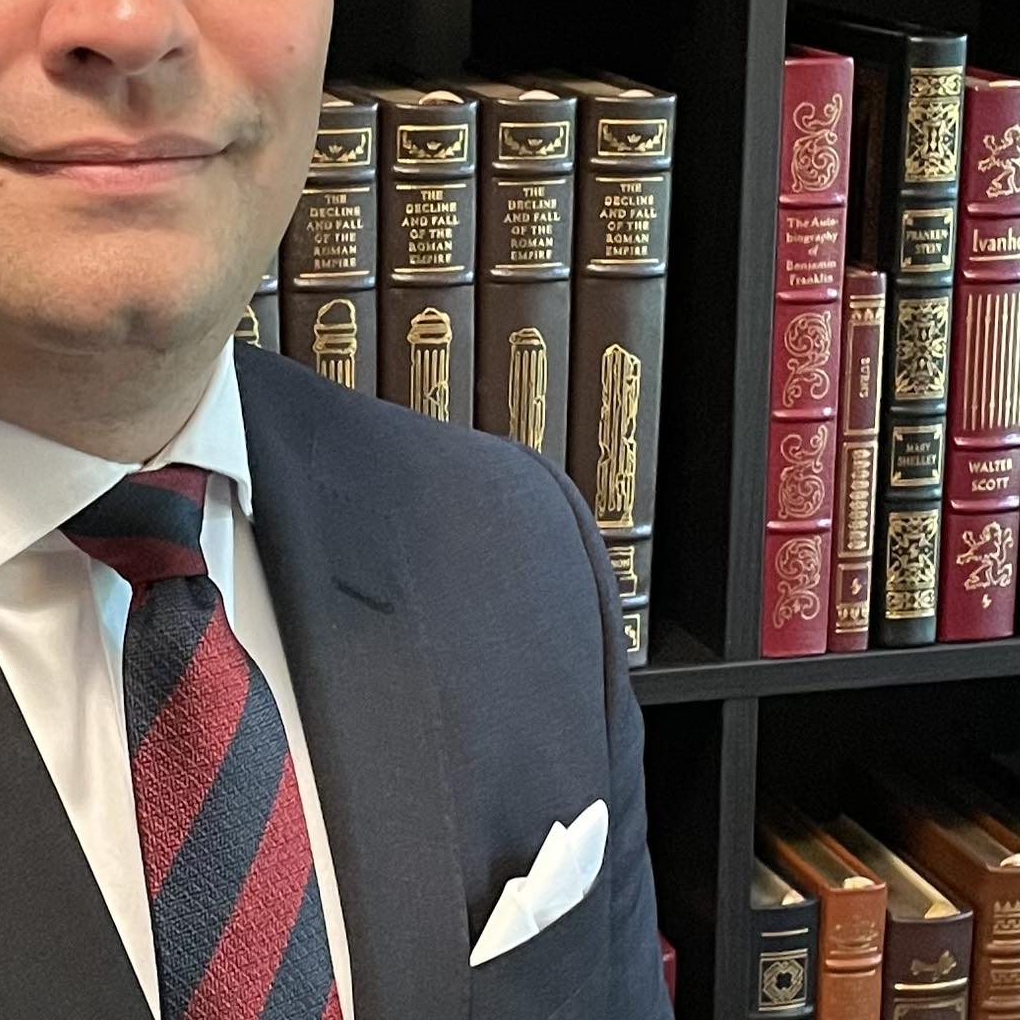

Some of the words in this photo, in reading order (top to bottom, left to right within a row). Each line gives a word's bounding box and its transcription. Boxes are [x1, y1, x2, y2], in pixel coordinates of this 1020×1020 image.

[522, 186, 545, 197] THE
[619, 183, 642, 193] THE
[325, 194, 347, 204] THE
[420, 190, 444, 201] THE
[604, 194, 654, 206] DECLINE
[405, 202, 457, 213] DECLINE
[508, 199, 557, 211] DECLINE
[309, 206, 361, 218] DECLINE
[503, 213, 530, 223] AND
[533, 211, 561, 222] FALL
[599, 209, 626, 219] AND
[629, 207, 658, 218] FALL
[306, 220, 333, 231] AND
[335, 217, 364, 229] FALL
[401, 216, 428, 227] AND
[431, 214, 460, 226] FALL
[607, 221, 622, 231] OF
[627, 220, 649, 230] THE
[786, 217, 809, 228] The
[410, 229, 424, 239] OF
[429, 228, 453, 239] THE
[511, 226, 527, 235] OF
[530, 224, 553, 234] THE
[314, 233, 329, 244] OF
[335, 232, 356, 242] THE
[510, 237, 554, 249] ROMAN
[605, 233, 649, 244] ROMAN
[786, 231, 838, 244] biography
[313, 245, 357, 256] ROMAN
[408, 240, 453, 252] ROMAN
[605, 245, 648, 257] EMPIRE
[808, 244, 819, 256] of
[915, 243, 942, 254] STEIN
[409, 253, 452, 265] EMPIRE
[510, 249, 552, 261] EMPIRE
[314, 257, 357, 269] EMPIRE
[786, 260, 836, 271] Benjamin
[789, 273, 833, 286] Franklin
[906, 442, 931, 453] MARY
[897, 454, 937, 467] SHELLEY
[968, 458, 1013, 473] WALTER
[972, 477, 1009, 492] SCOTT
